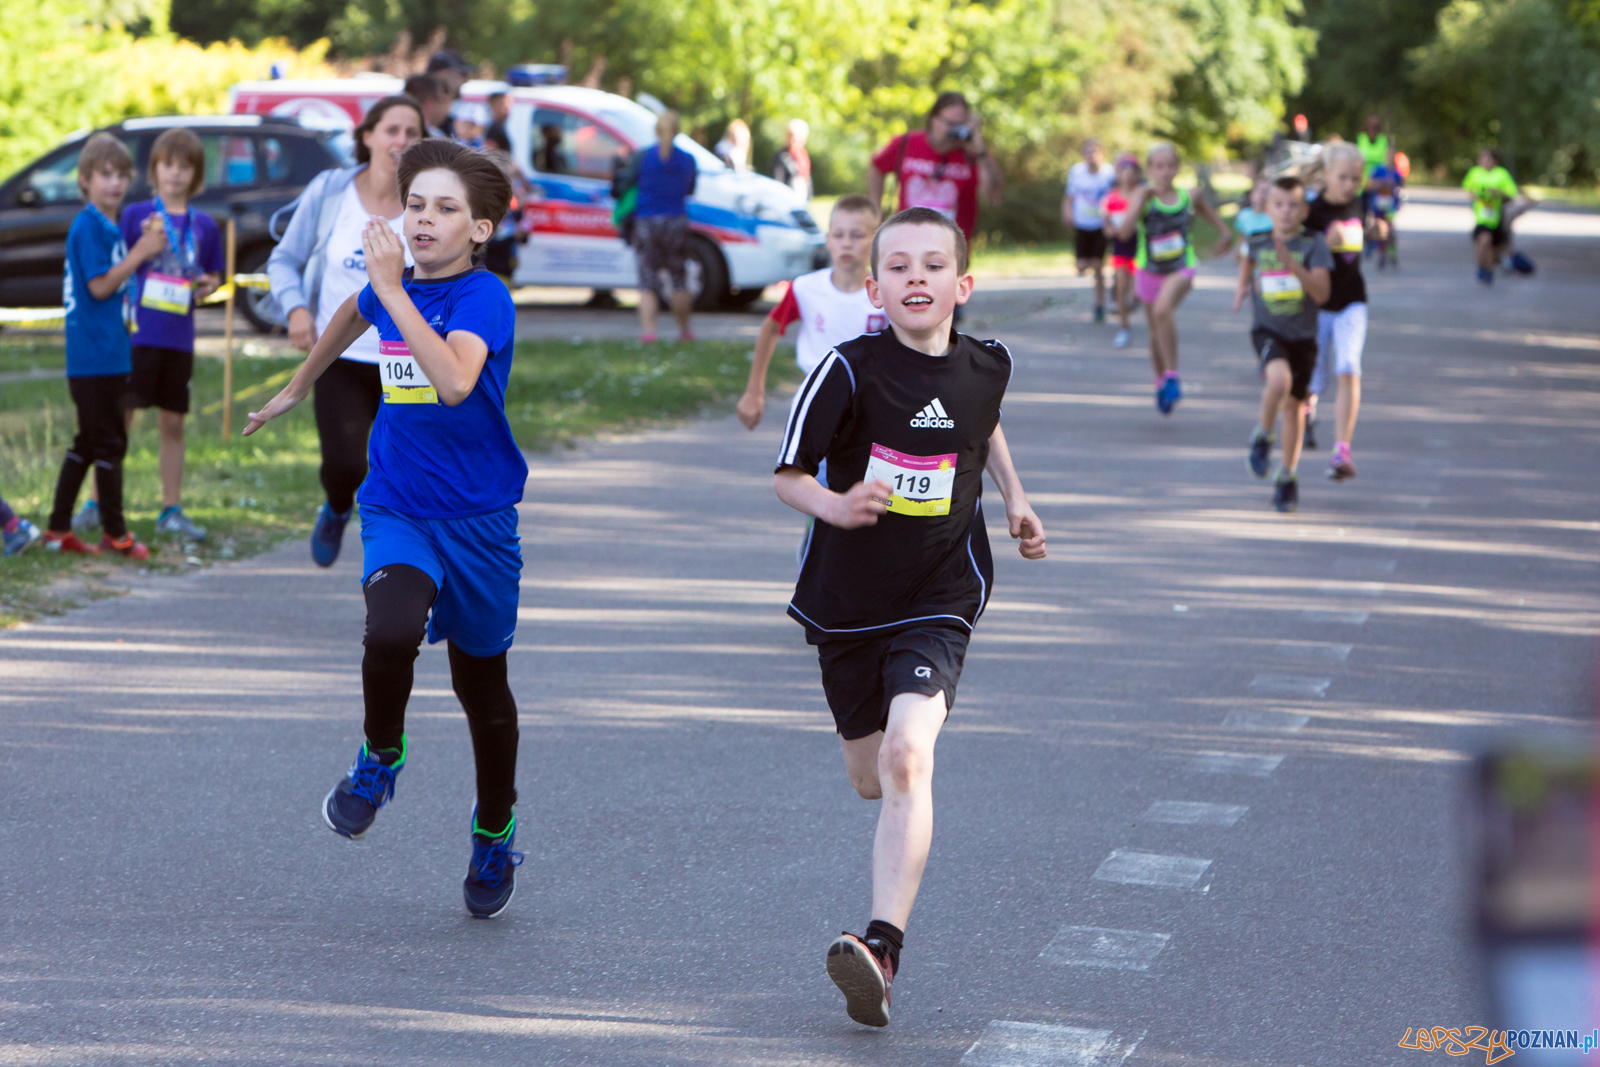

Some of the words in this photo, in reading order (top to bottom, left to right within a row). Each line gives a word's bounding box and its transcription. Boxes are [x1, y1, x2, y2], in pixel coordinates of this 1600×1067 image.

[386, 362, 414, 380] 104
[910, 416, 954, 429] adidas
[894, 473, 931, 494] 119
